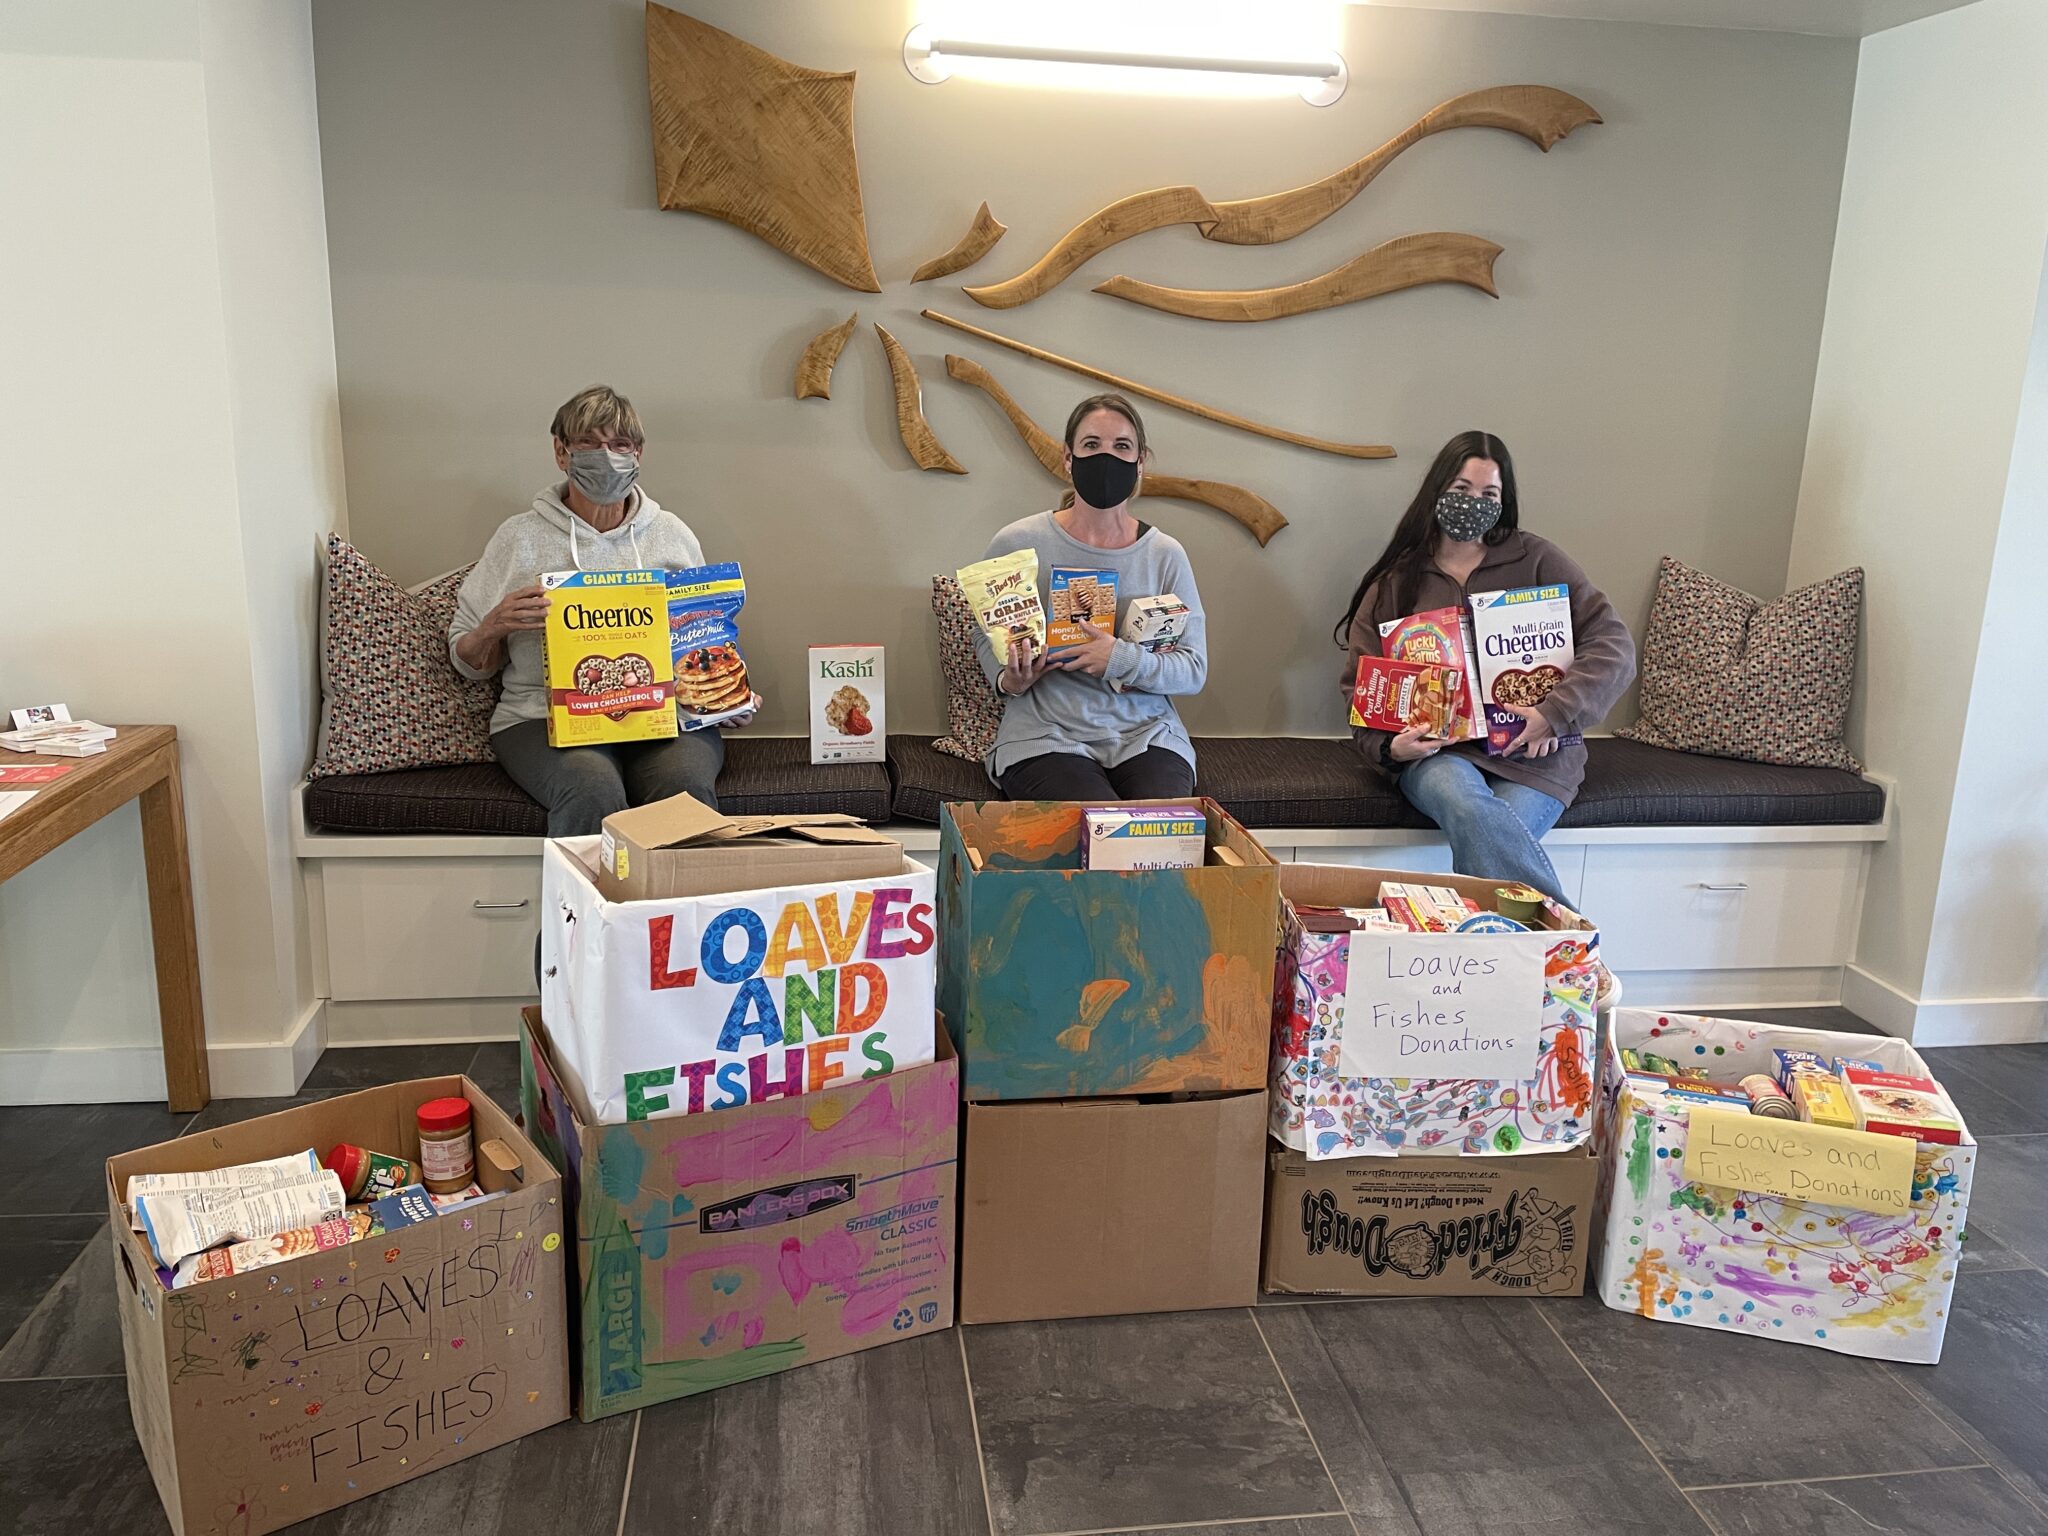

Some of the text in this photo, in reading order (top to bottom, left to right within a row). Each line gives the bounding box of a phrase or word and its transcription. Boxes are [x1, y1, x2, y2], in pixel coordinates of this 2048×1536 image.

[583, 572, 652, 585] GIANT SIZE
[666, 587, 691, 596] AMILY
[694, 584, 711, 592] SIZE
[983, 612, 991, 622] 7
[994, 596, 1038, 618] GRAIN
[1505, 591, 1538, 604] FAMILY
[1540, 588, 1560, 599] SIZE
[563, 602, 654, 630] Cheerios
[1512, 620, 1564, 636] Multi Grain
[583, 634, 607, 642] 100%
[625, 632, 647, 640] OATS
[670, 621, 725, 647] Buttermilk
[1051, 626, 1076, 635] Honey
[1485, 631, 1566, 657] Cheerios
[820, 659, 874, 678] Kashi
[1403, 650, 1440, 664] harms
[600, 694, 651, 706] CHOLESTEROL
[1364, 668, 1381, 718] Pearl Milling
[1374, 676, 1388, 714] Company
[1400, 683, 1409, 715] COMPLETE
[1129, 822, 1195, 836] FAMILY SIZE
[648, 888, 934, 991] LOAVES
[1387, 946, 1499, 979] Loaves
[1432, 981, 1462, 995] and
[716, 962, 888, 1052] AND
[1373, 1000, 1466, 1028] Fishes
[1400, 1027, 1514, 1056] Donations
[1711, 1124, 1881, 1171] Loaves and
[1700, 1151, 1904, 1208] Fishes Donations
[709, 1183, 849, 1225] BANKERS BOX
[845, 1199, 939, 1232] SmoothMove
[1358, 1195, 1484, 1209] Need a Dough? Let Us Know!!
[880, 1217, 937, 1241] CLASSIC
[1302, 1189, 1524, 1276] Fried Dough
[885, 1245, 900, 1255] Tape
[902, 1237, 932, 1250] Assembly
[1492, 1220, 1574, 1287] FRIED DOUGH
[855, 1267, 881, 1278] Handles
[883, 1262, 897, 1271] with
[296, 1245, 499, 1351] LOAVES
[920, 1306, 936, 1315] USA
[608, 1271, 633, 1372] LARGE
[365, 1347, 403, 1395] &
[310, 1371, 497, 1483] FISHES
